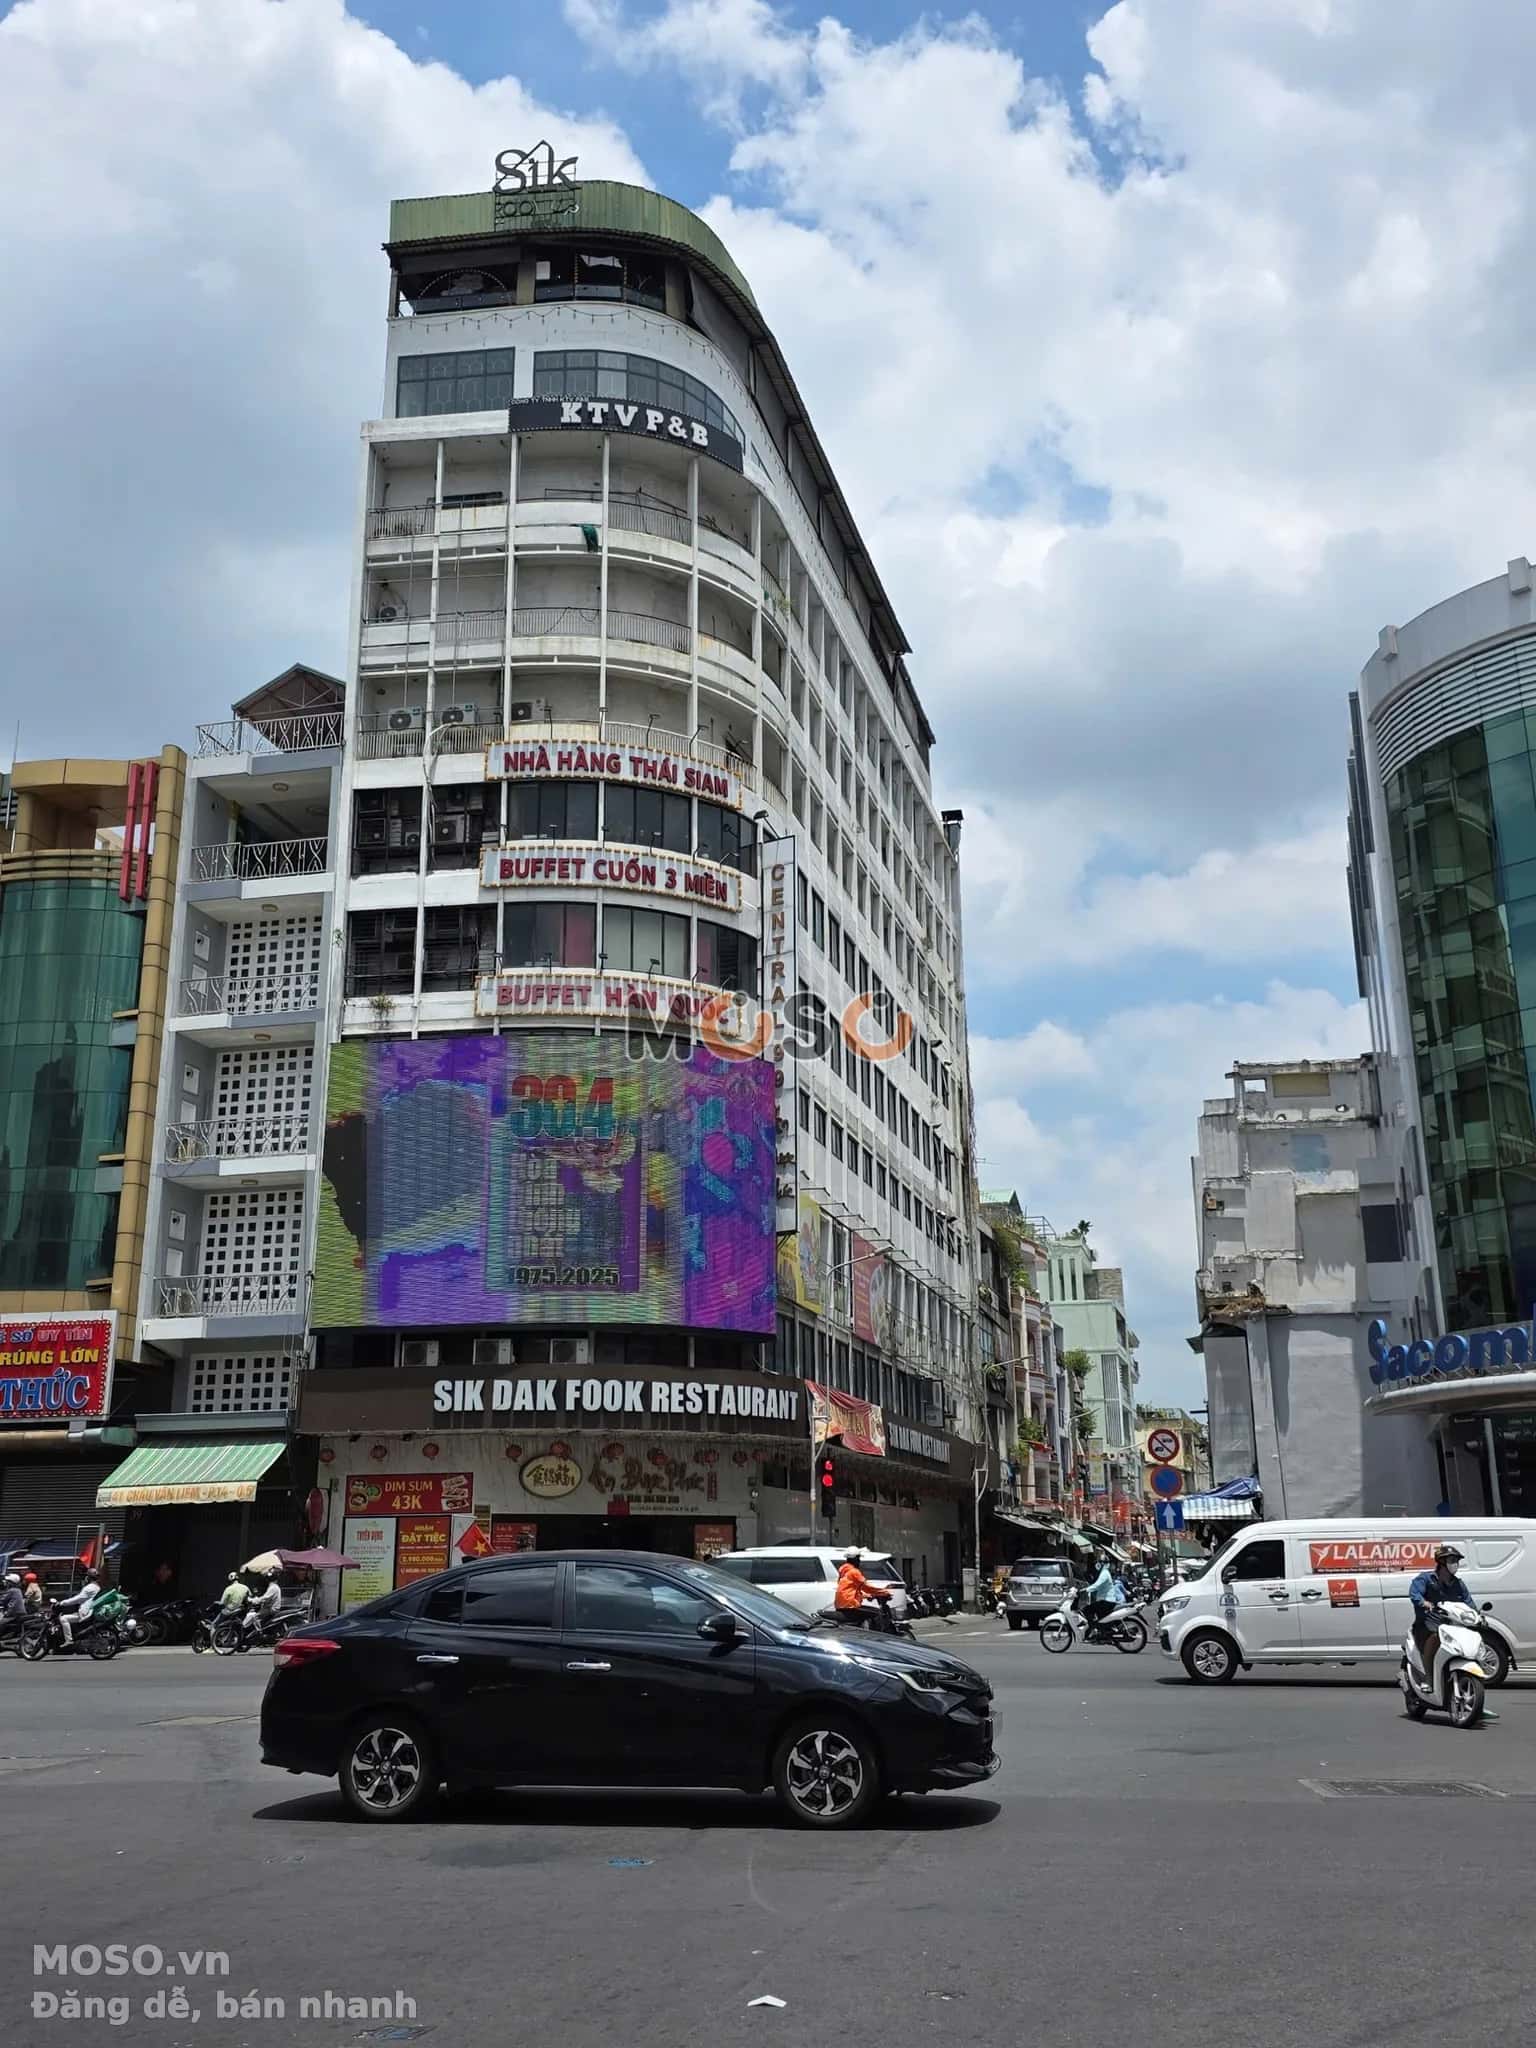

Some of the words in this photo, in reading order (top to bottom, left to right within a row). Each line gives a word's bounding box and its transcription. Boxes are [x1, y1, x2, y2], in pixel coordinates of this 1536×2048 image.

[561, 402, 638, 427] KTV
[646, 409, 709, 447] P&B
[504, 745, 550, 772] NHÀ
[557, 745, 621, 774] HÀNG
[630, 757, 678, 785] THÁI
[684, 768, 729, 798] SIAM
[500, 858, 585, 880] BUFFET
[593, 857, 656, 886] CUỐN
[665, 869, 677, 889] 3
[684, 871, 728, 902] MIỀN
[771, 863, 785, 1029] CENTRAL
[498, 984, 592, 1006] BUFFET
[605, 983, 657, 1011] HÀN
[37, 1329, 60, 1342] UY
[64, 1327, 93, 1341] TÍN
[60, 1347, 99, 1364] LỚN
[1368, 1304, 1536, 1384] Sacom
[0, 1367, 90, 1411] THỨC
[434, 1379, 484, 1412] SIK
[493, 1379, 556, 1412] DAK
[566, 1378, 644, 1413] FOOK
[651, 1381, 799, 1420] RESTAURANT
[385, 1480, 406, 1492] DIM
[409, 1481, 433, 1491] SUM
[391, 1495, 422, 1510] 43K
